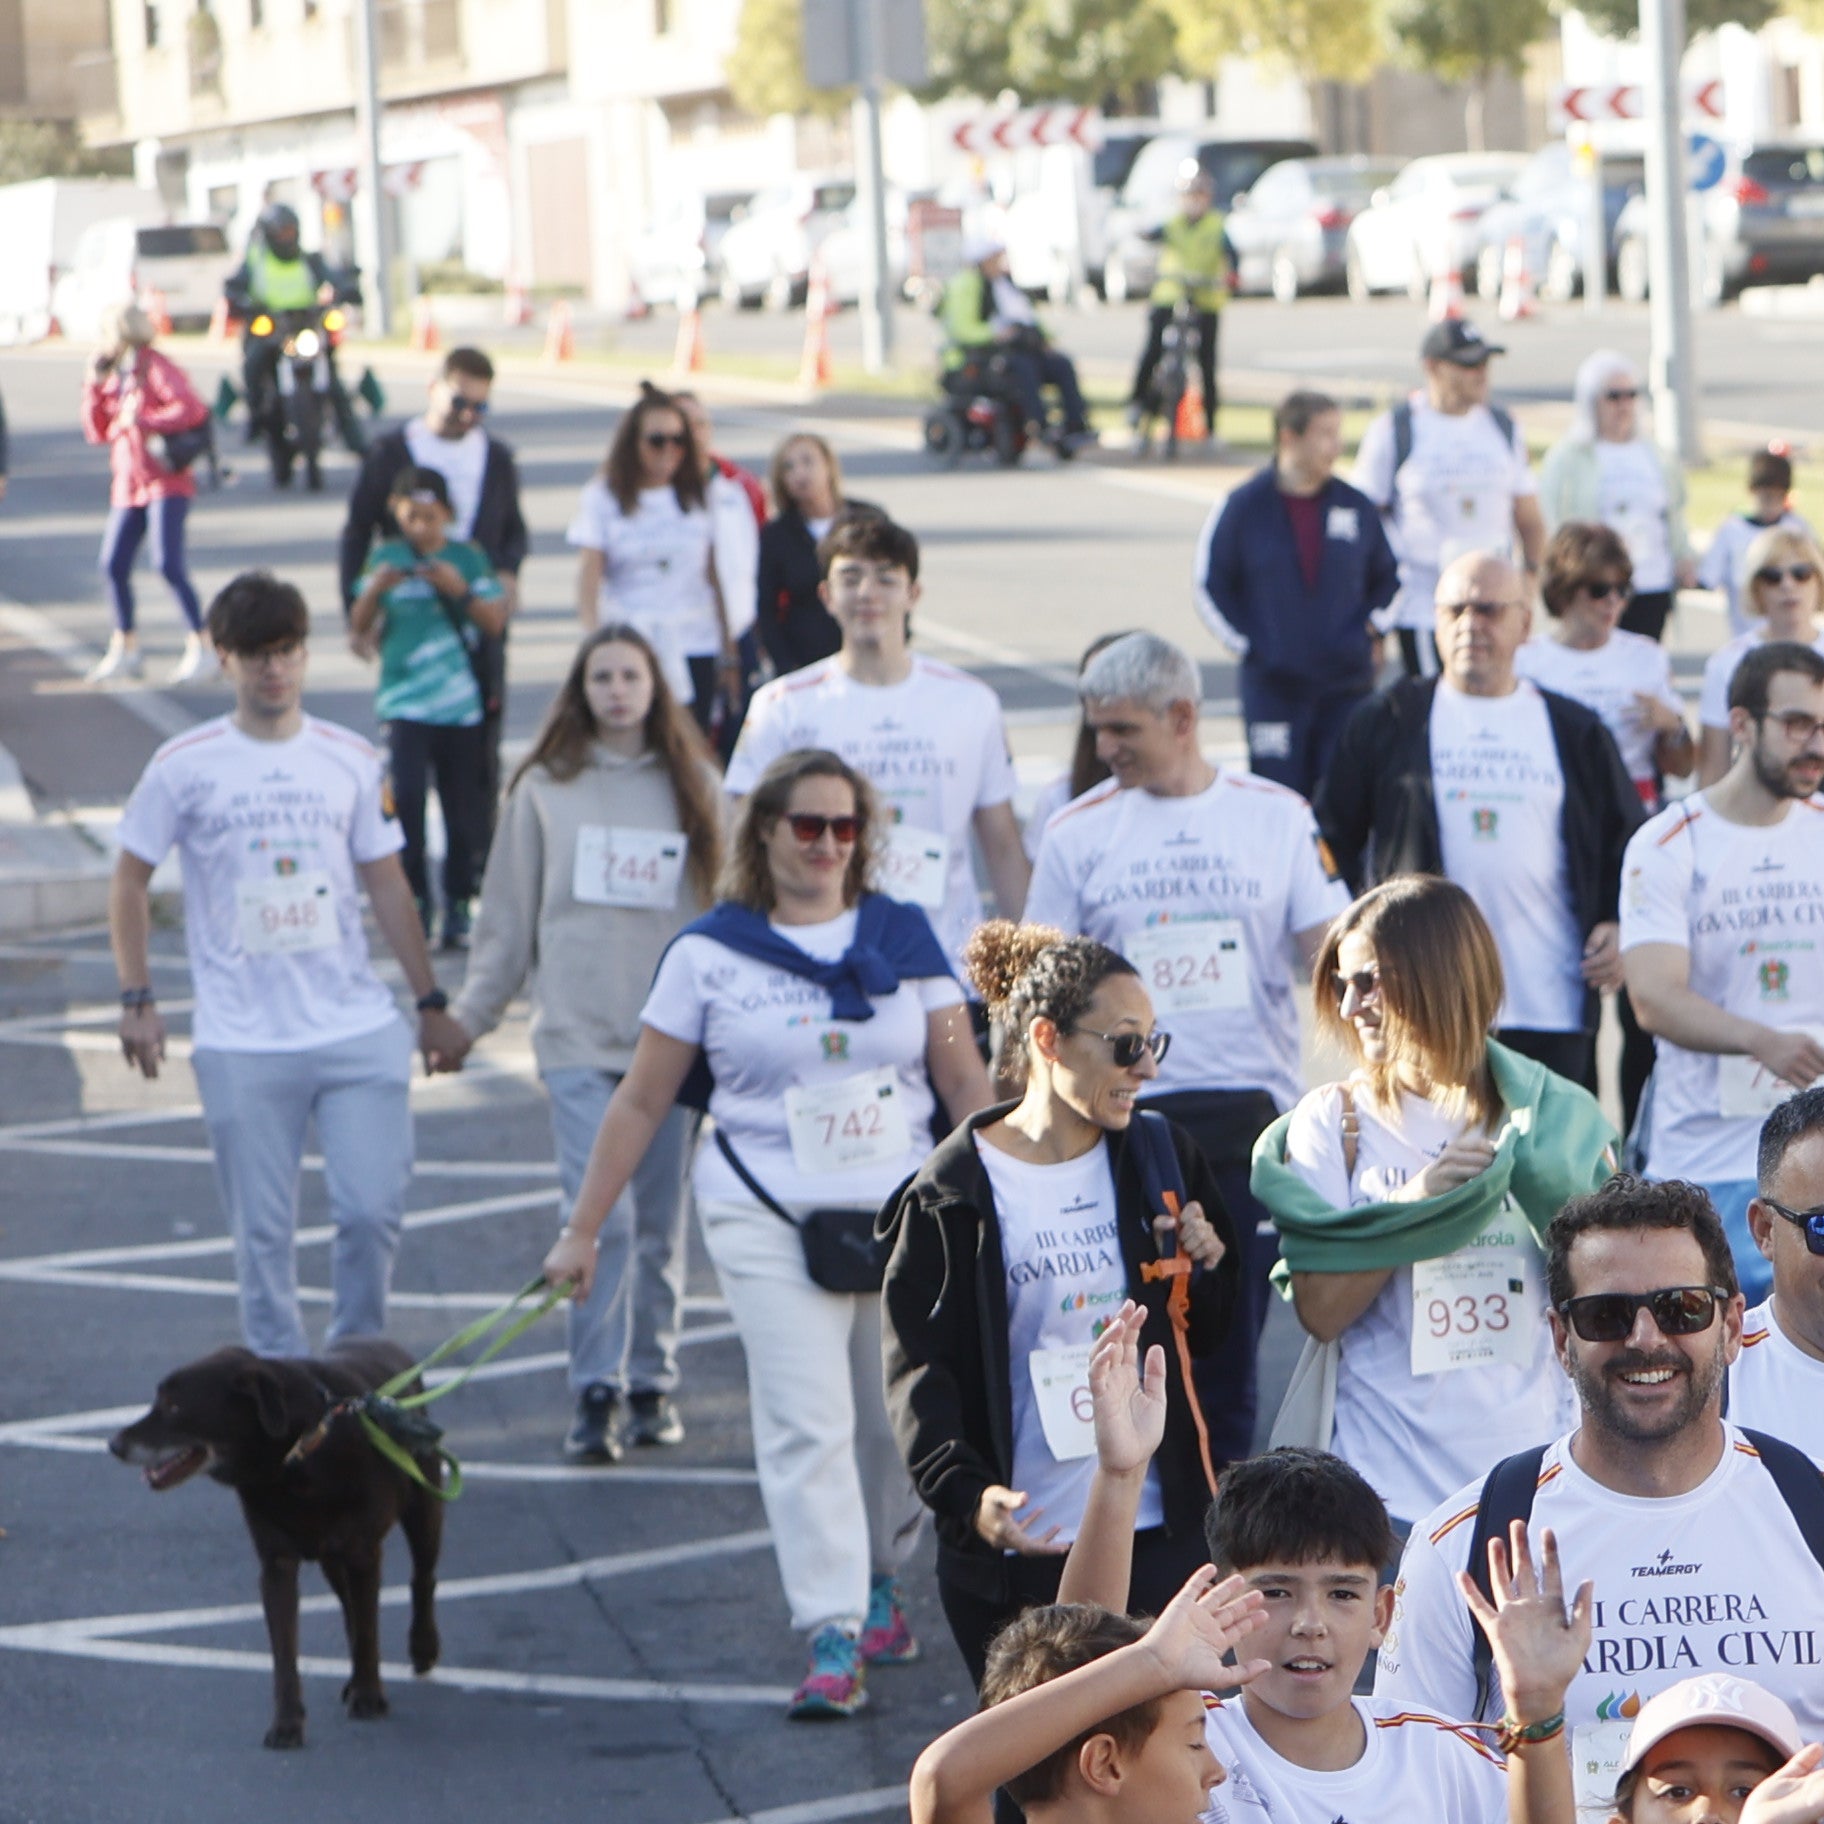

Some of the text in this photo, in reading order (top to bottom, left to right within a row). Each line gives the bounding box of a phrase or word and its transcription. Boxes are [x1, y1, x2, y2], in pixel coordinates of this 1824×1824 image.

[600, 850, 660, 884] 744
[1207, 873, 1263, 900] CIVIL
[1745, 881, 1822, 902] CARRERA
[1153, 953, 1221, 989] 824
[815, 1104, 884, 1145] 742
[1427, 1292, 1511, 1338] 933
[1630, 1562, 1703, 1579] TEAMERGY
[1617, 1593, 1770, 1628] CARRERA
[1716, 1630, 1822, 1667] CIVIL
